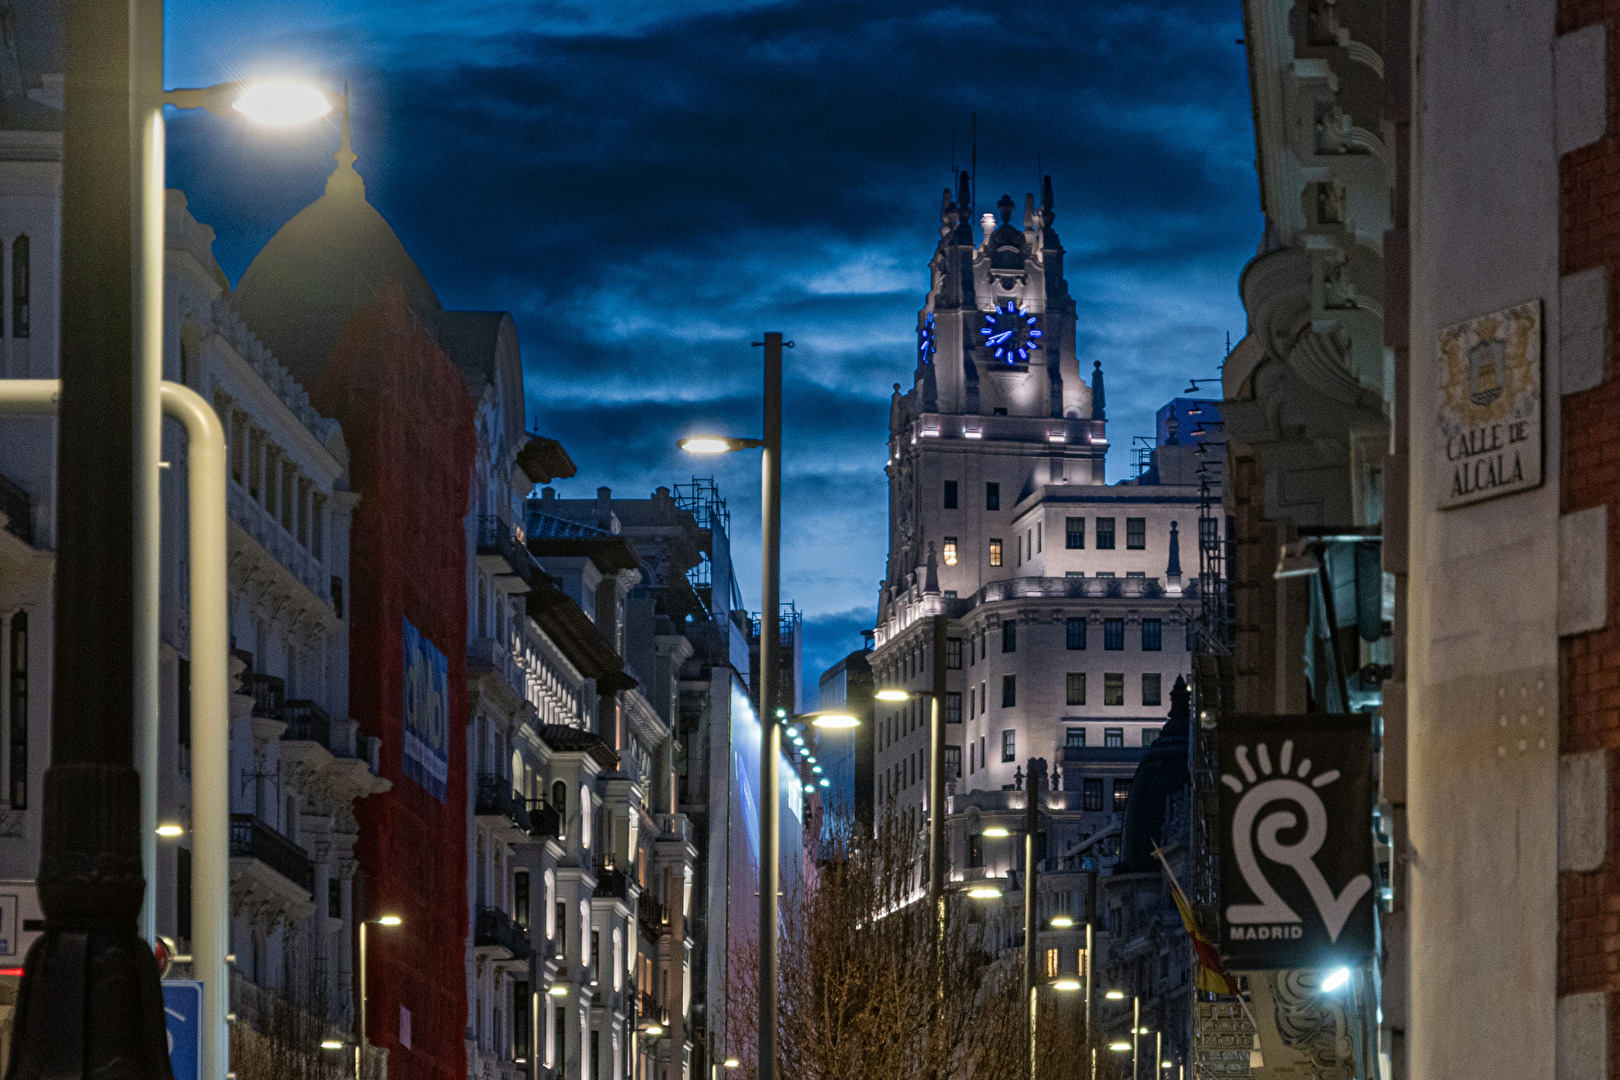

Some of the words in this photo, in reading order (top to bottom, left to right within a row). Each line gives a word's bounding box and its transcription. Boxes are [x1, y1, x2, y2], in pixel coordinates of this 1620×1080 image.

[1447, 425, 1503, 461] CALLE
[1508, 421, 1529, 443] DE
[1230, 927, 1302, 940] MADRID
